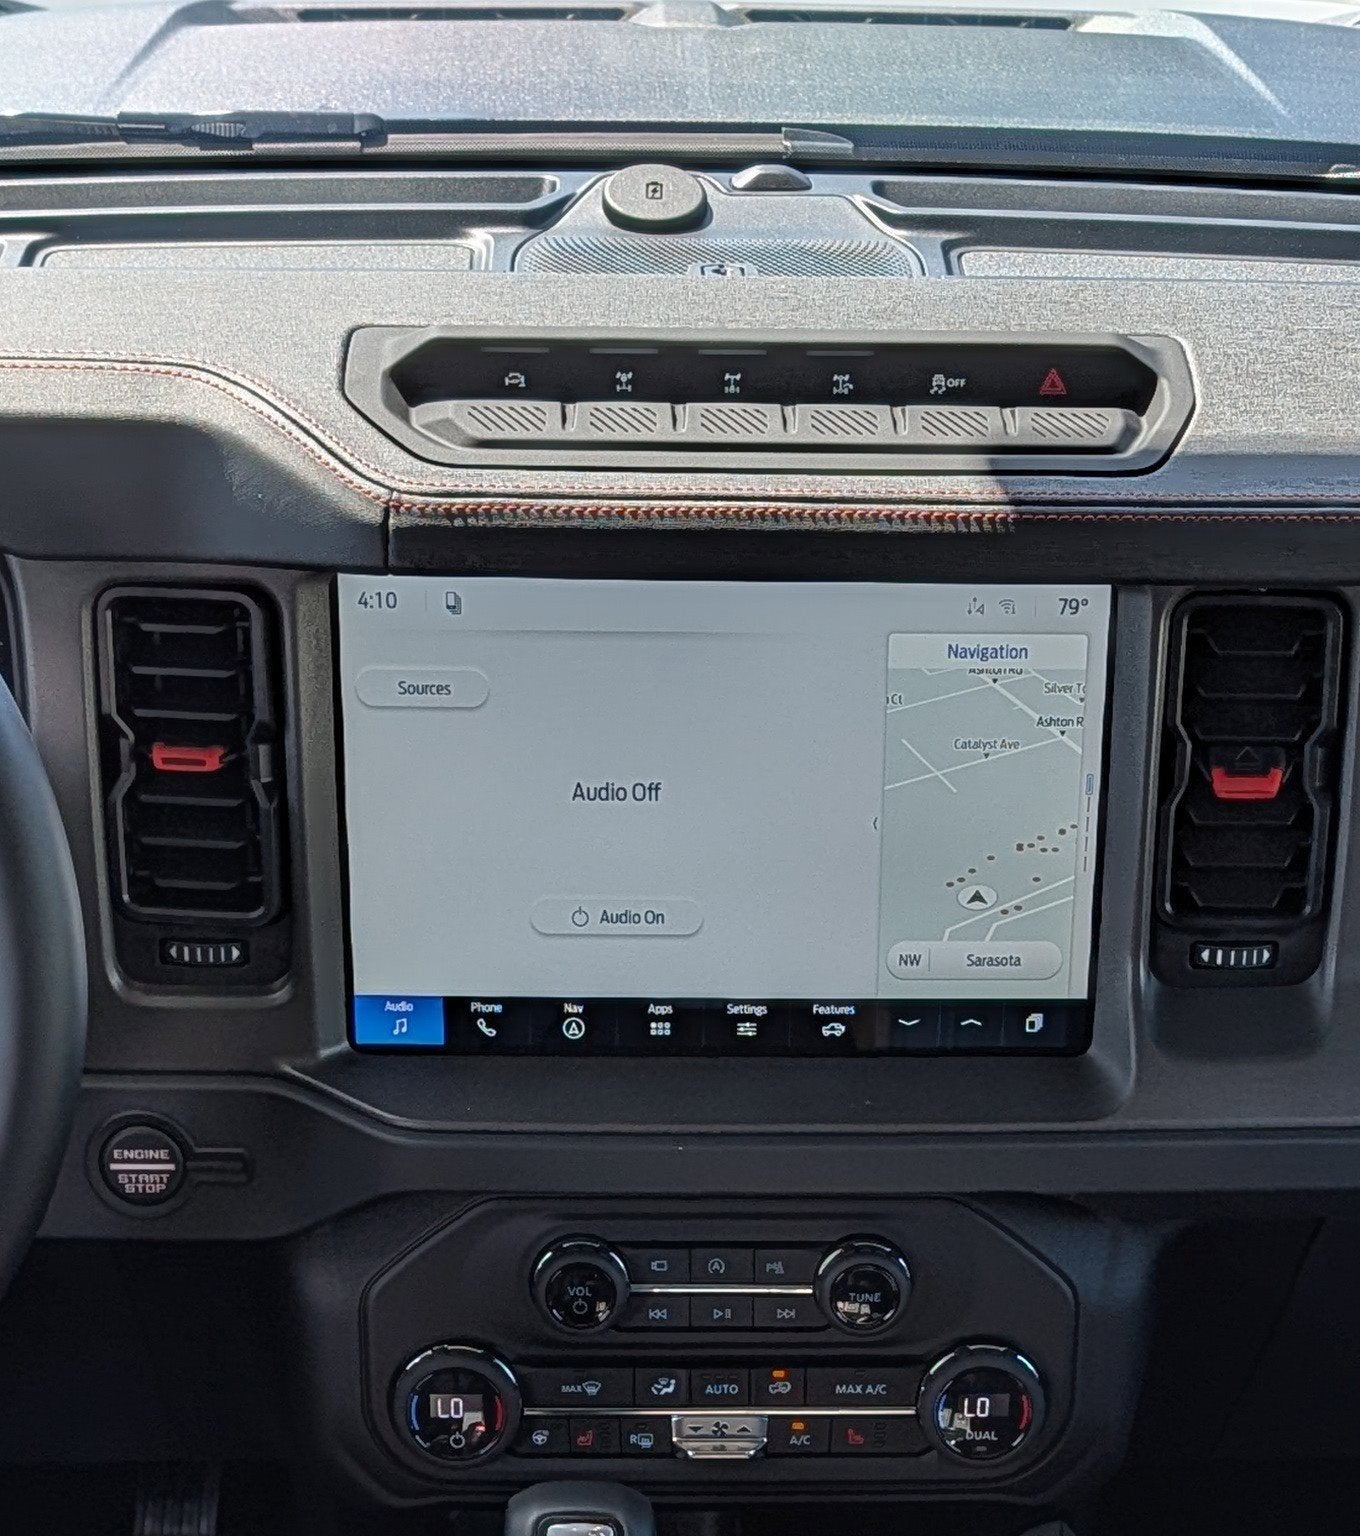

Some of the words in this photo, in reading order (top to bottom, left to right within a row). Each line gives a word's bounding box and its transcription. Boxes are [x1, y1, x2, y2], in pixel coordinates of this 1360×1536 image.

[946, 378, 967, 388] OFF
[357, 591, 398, 609] 4:10
[947, 644, 1028, 662] Navigation
[398, 680, 452, 696] Sources
[1044, 682, 1073, 694] Silver
[1036, 717, 1074, 727] Ashton
[954, 739, 996, 750] Catalyst
[997, 739, 1020, 750] Ave
[572, 782, 628, 802] Audio
[632, 782, 662, 802] Off
[599, 909, 641, 925] Audio
[645, 910, 665, 925] On
[899, 954, 922, 967] NW
[967, 954, 1022, 967] Sarasota
[384, 1001, 414, 1012] Audio
[471, 1002, 503, 1013] Phone
[564, 1003, 583, 1014] Nav
[648, 1004, 673, 1016] Apps
[727, 1003, 768, 1016] Settings
[813, 1004, 855, 1015] Features
[113, 1149, 170, 1160] ENGINE
[118, 1174, 170, 1184] START
[125, 1183, 166, 1193] STOP
[568, 1286, 591, 1297] VOL
[849, 1292, 881, 1303] TUNE
[705, 1384, 739, 1395] AUTO
[836, 1384, 863, 1395] MAX
[865, 1384, 887, 1395] A/C
[437, 1397, 464, 1419] LO
[964, 1397, 990, 1418] LO
[790, 1434, 811, 1446] A/C
[965, 1430, 998, 1441] DUAL
